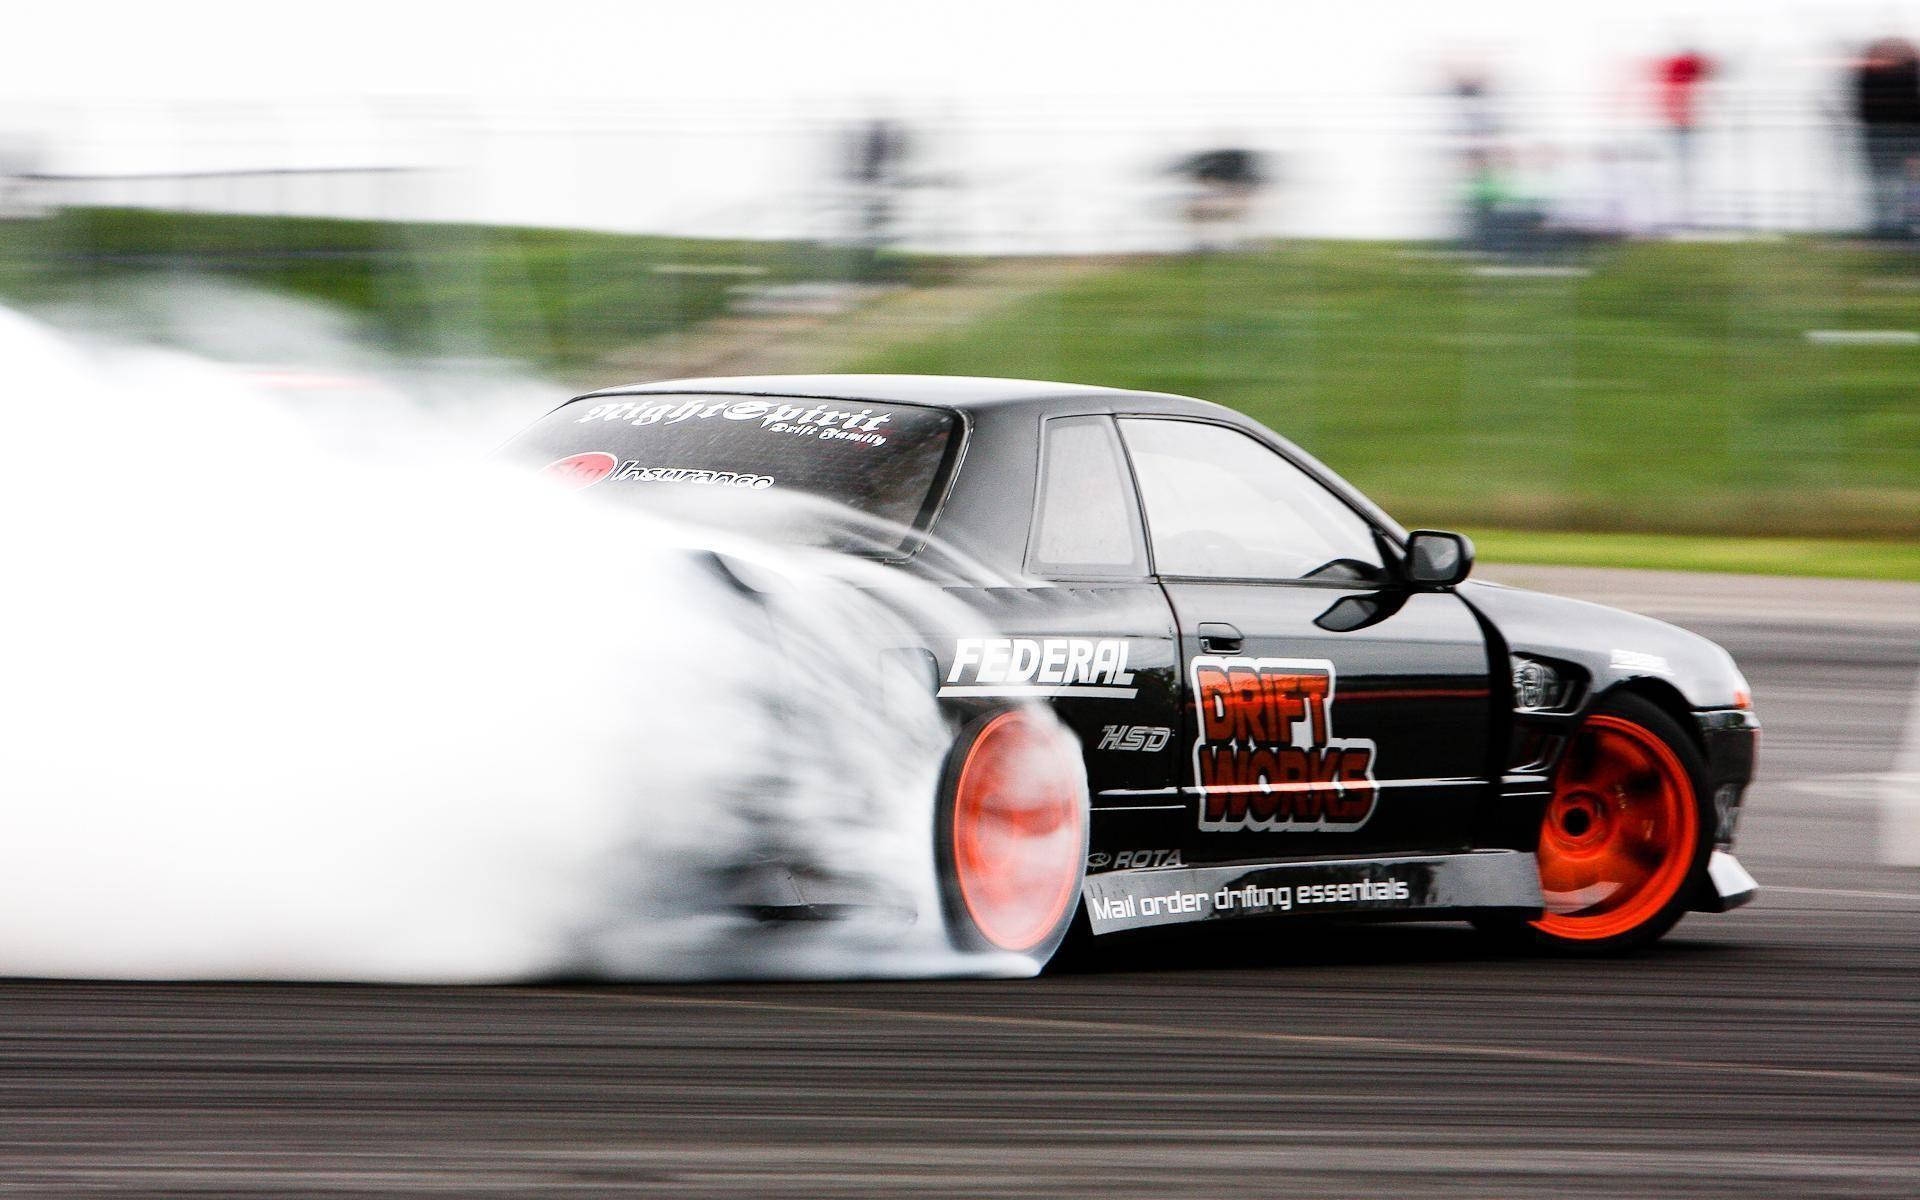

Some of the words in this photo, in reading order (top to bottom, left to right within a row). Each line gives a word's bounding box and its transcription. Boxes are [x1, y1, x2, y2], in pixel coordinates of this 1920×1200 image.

[611, 459, 775, 490] Insurance
[946, 638, 1136, 686] FEDERAL
[1197, 665, 1329, 748] DRIFT
[1097, 724, 1172, 752] HSD
[1200, 745, 1375, 824] WORKS
[1113, 849, 1183, 869] ROTA
[1091, 893, 1136, 921] Mail
[1140, 890, 1210, 915] order
[1214, 884, 1293, 911] drifting
[1296, 877, 1410, 904] essentials
